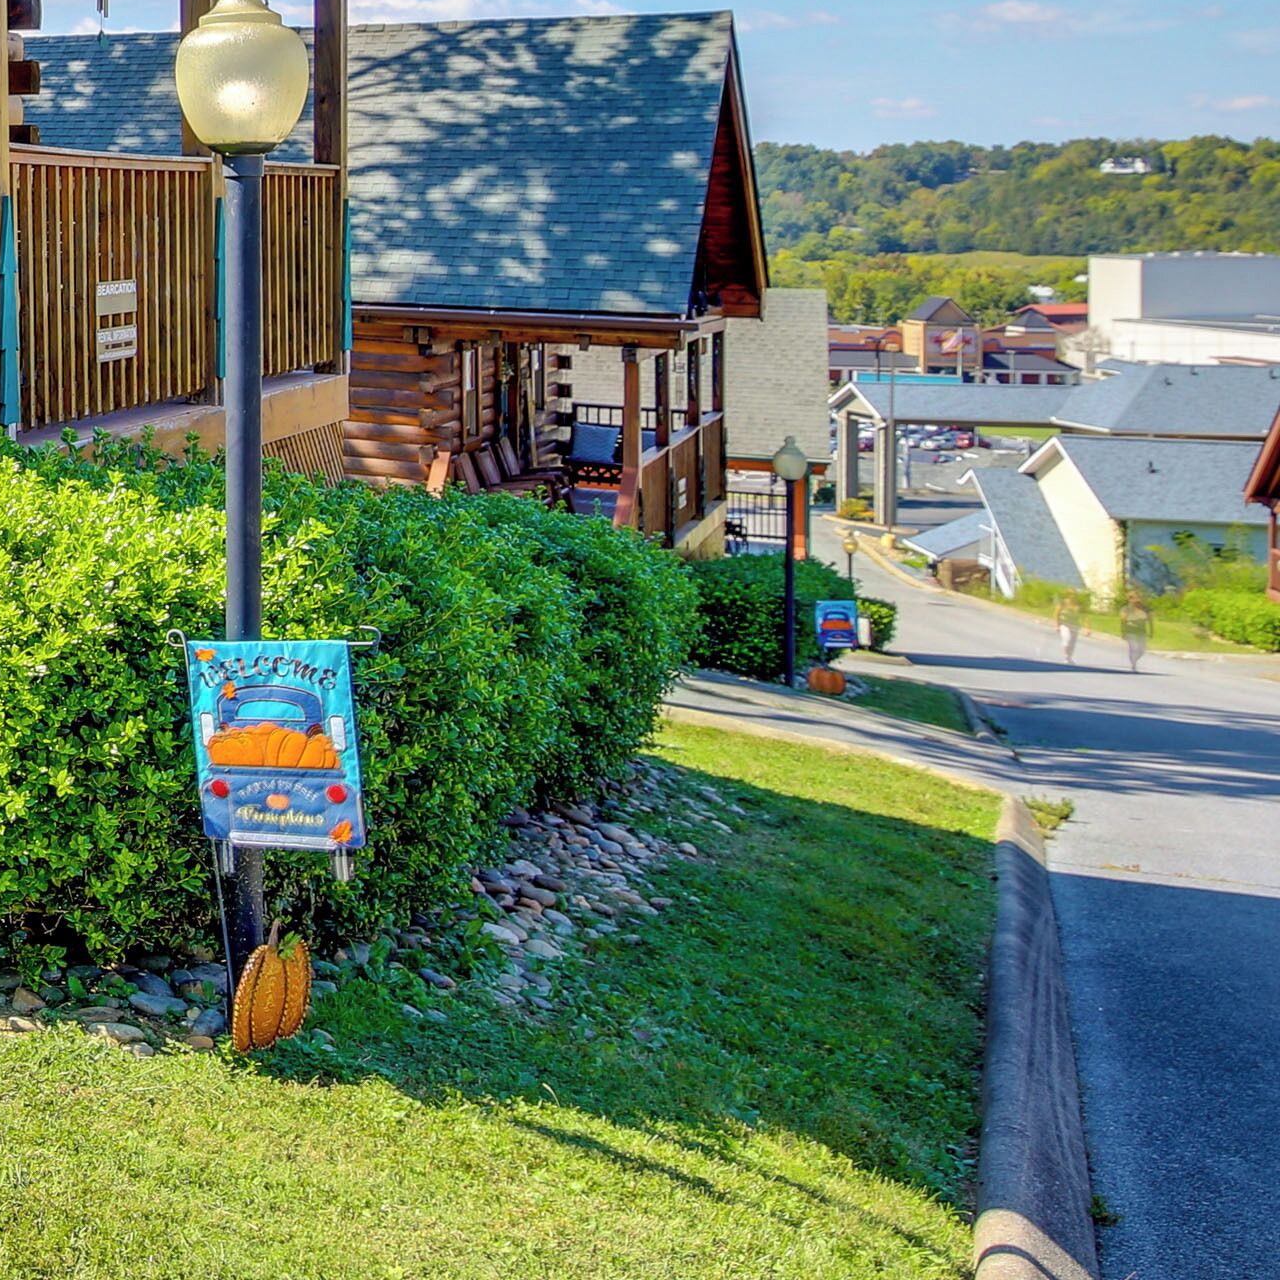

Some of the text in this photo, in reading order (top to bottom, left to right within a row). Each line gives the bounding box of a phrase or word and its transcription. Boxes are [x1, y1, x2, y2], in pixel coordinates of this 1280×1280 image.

[97, 283, 137, 296] BEARCATION
[199, 655, 337, 690] WELCOME
[236, 804, 324, 827] Pumpkins
